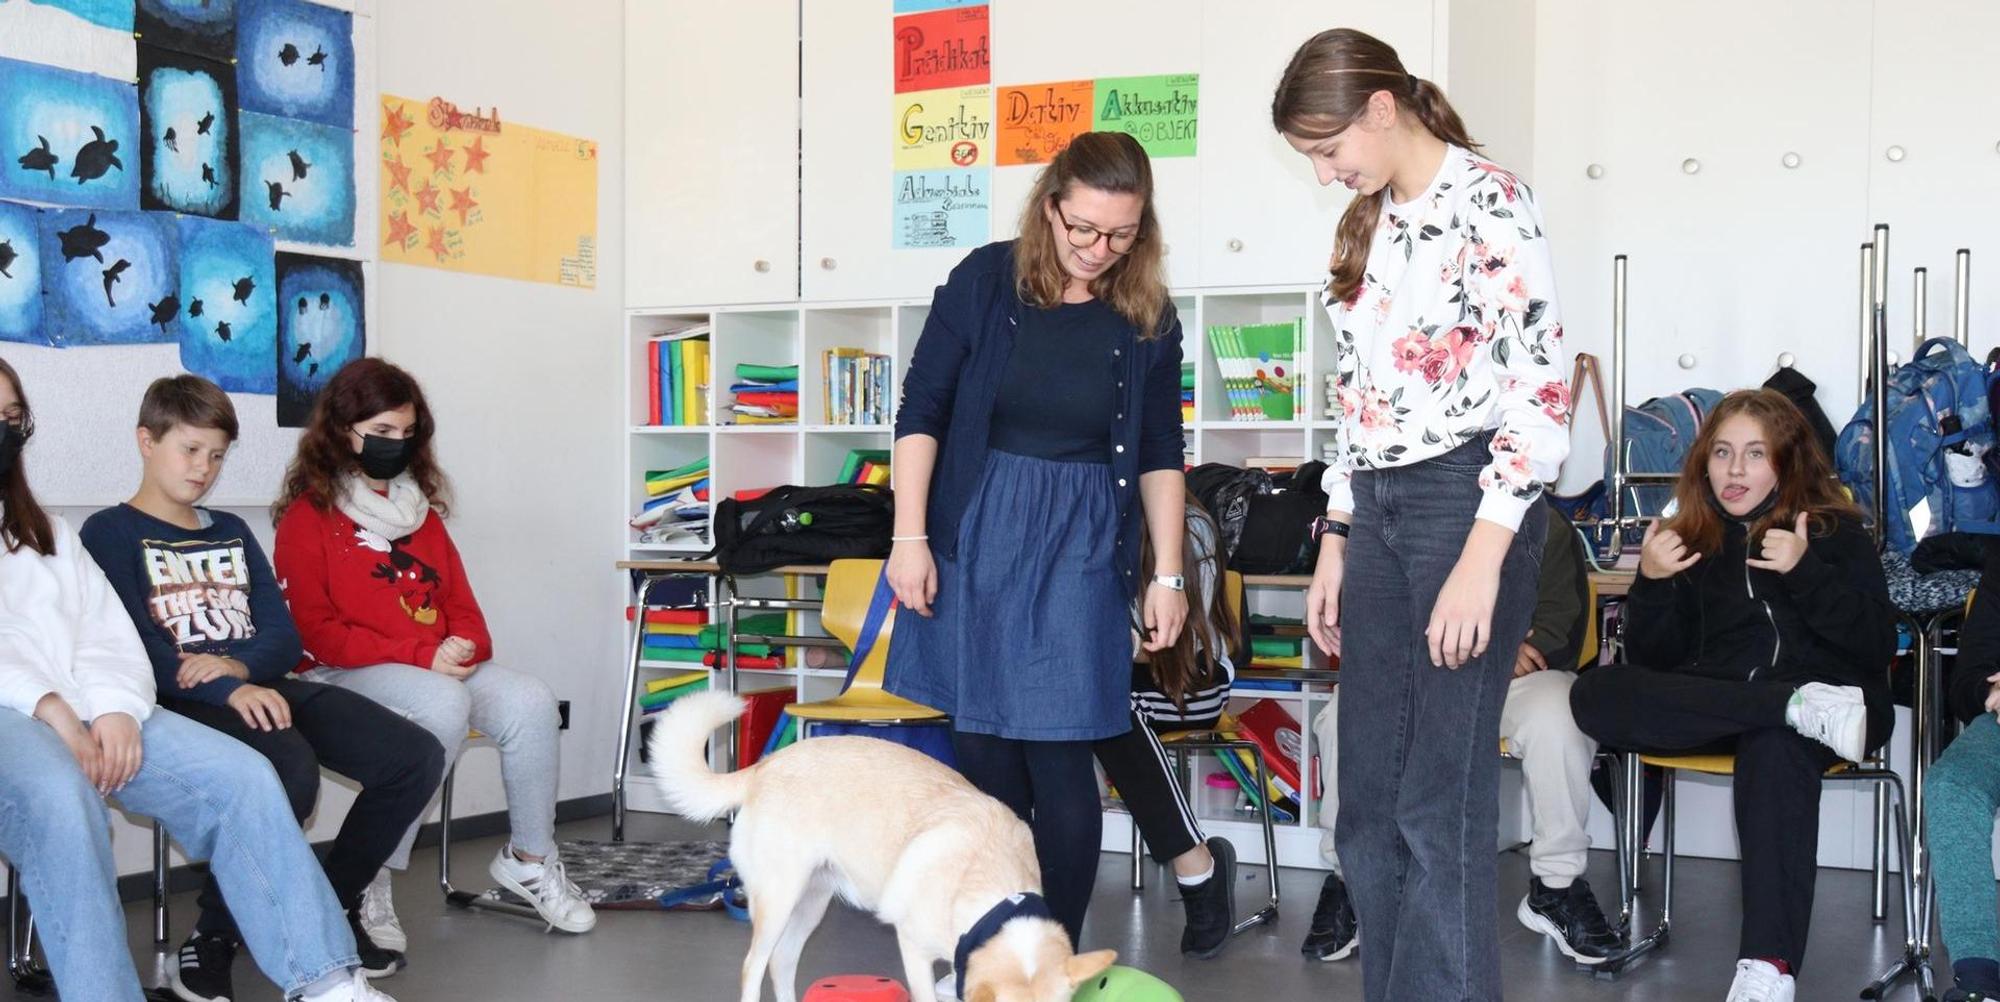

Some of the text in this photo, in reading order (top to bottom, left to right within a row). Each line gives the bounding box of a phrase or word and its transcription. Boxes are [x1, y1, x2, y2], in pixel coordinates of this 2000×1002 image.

[896, 26, 989, 77] Prädikat
[1006, 88, 1080, 125] Dativ
[1101, 89, 1197, 120] Akkusativ
[901, 103, 989, 145] Genitiv
[150, 588, 208, 620] THE
